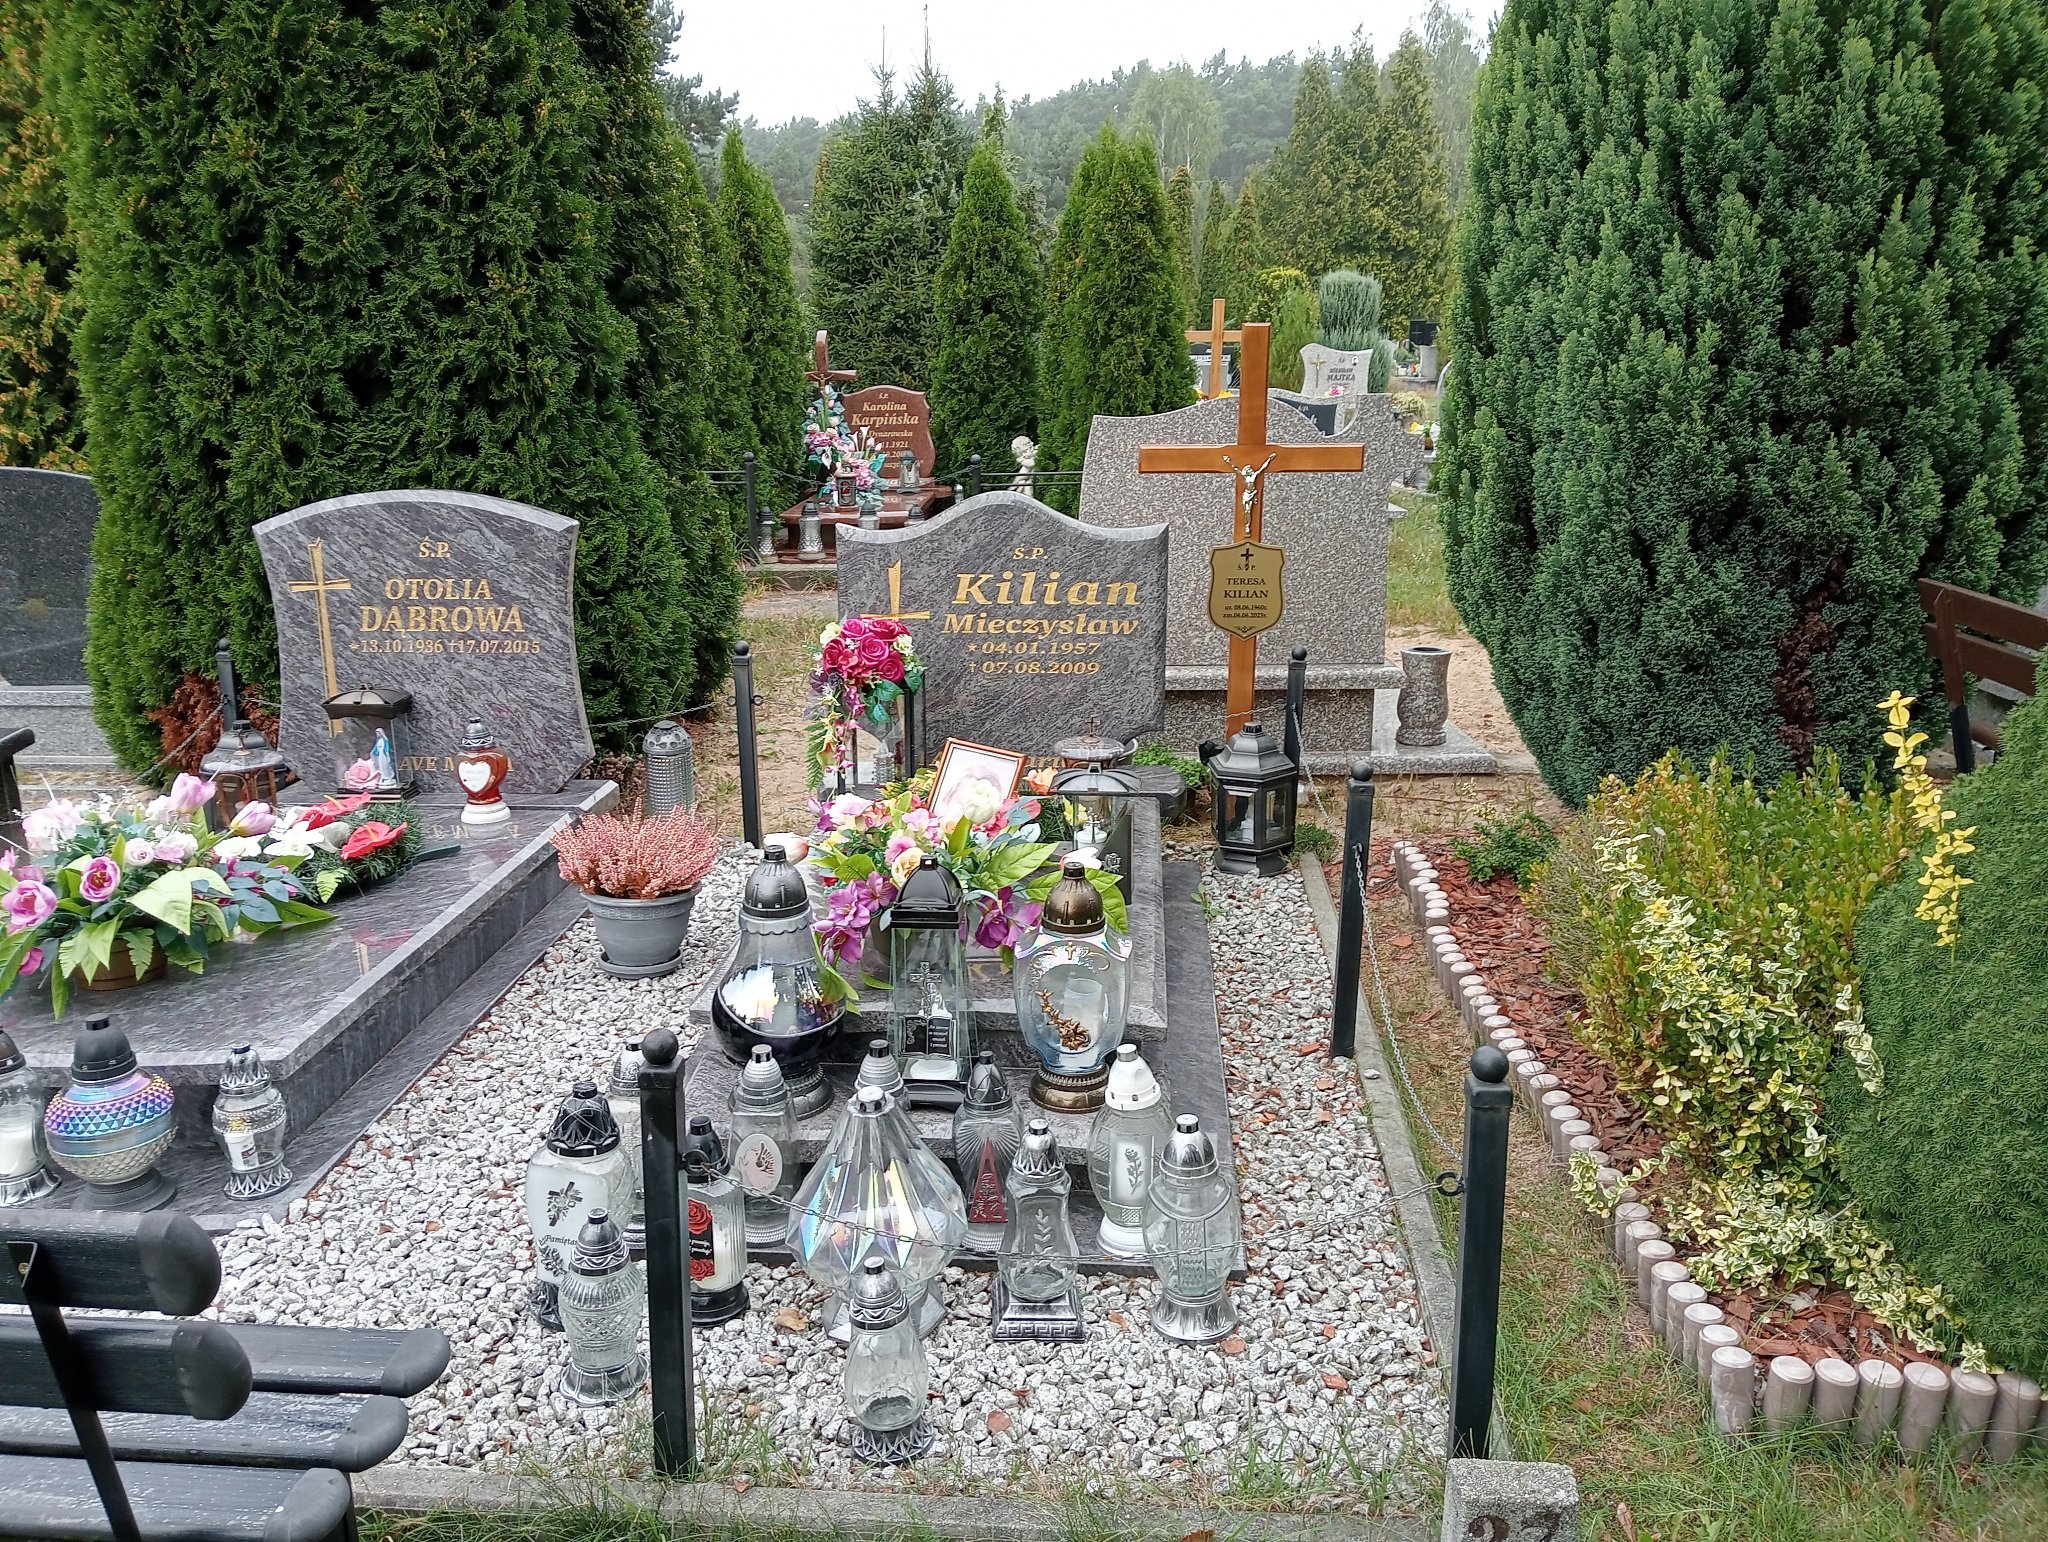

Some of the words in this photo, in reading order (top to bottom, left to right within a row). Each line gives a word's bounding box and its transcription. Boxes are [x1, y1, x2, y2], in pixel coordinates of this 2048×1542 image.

[863, 401, 907, 411] Karolina
[851, 412, 919, 428] Karpińska
[384, 578, 494, 601] OTOLIA
[951, 570, 1141, 606] Kilian
[1226, 577, 1266, 586] TERESA
[1223, 589, 1269, 599] KILIAN
[359, 604, 526, 638] DĄBROWA
[941, 612, 1140, 638] Mieczysław
[397, 757, 438, 771] AVE
